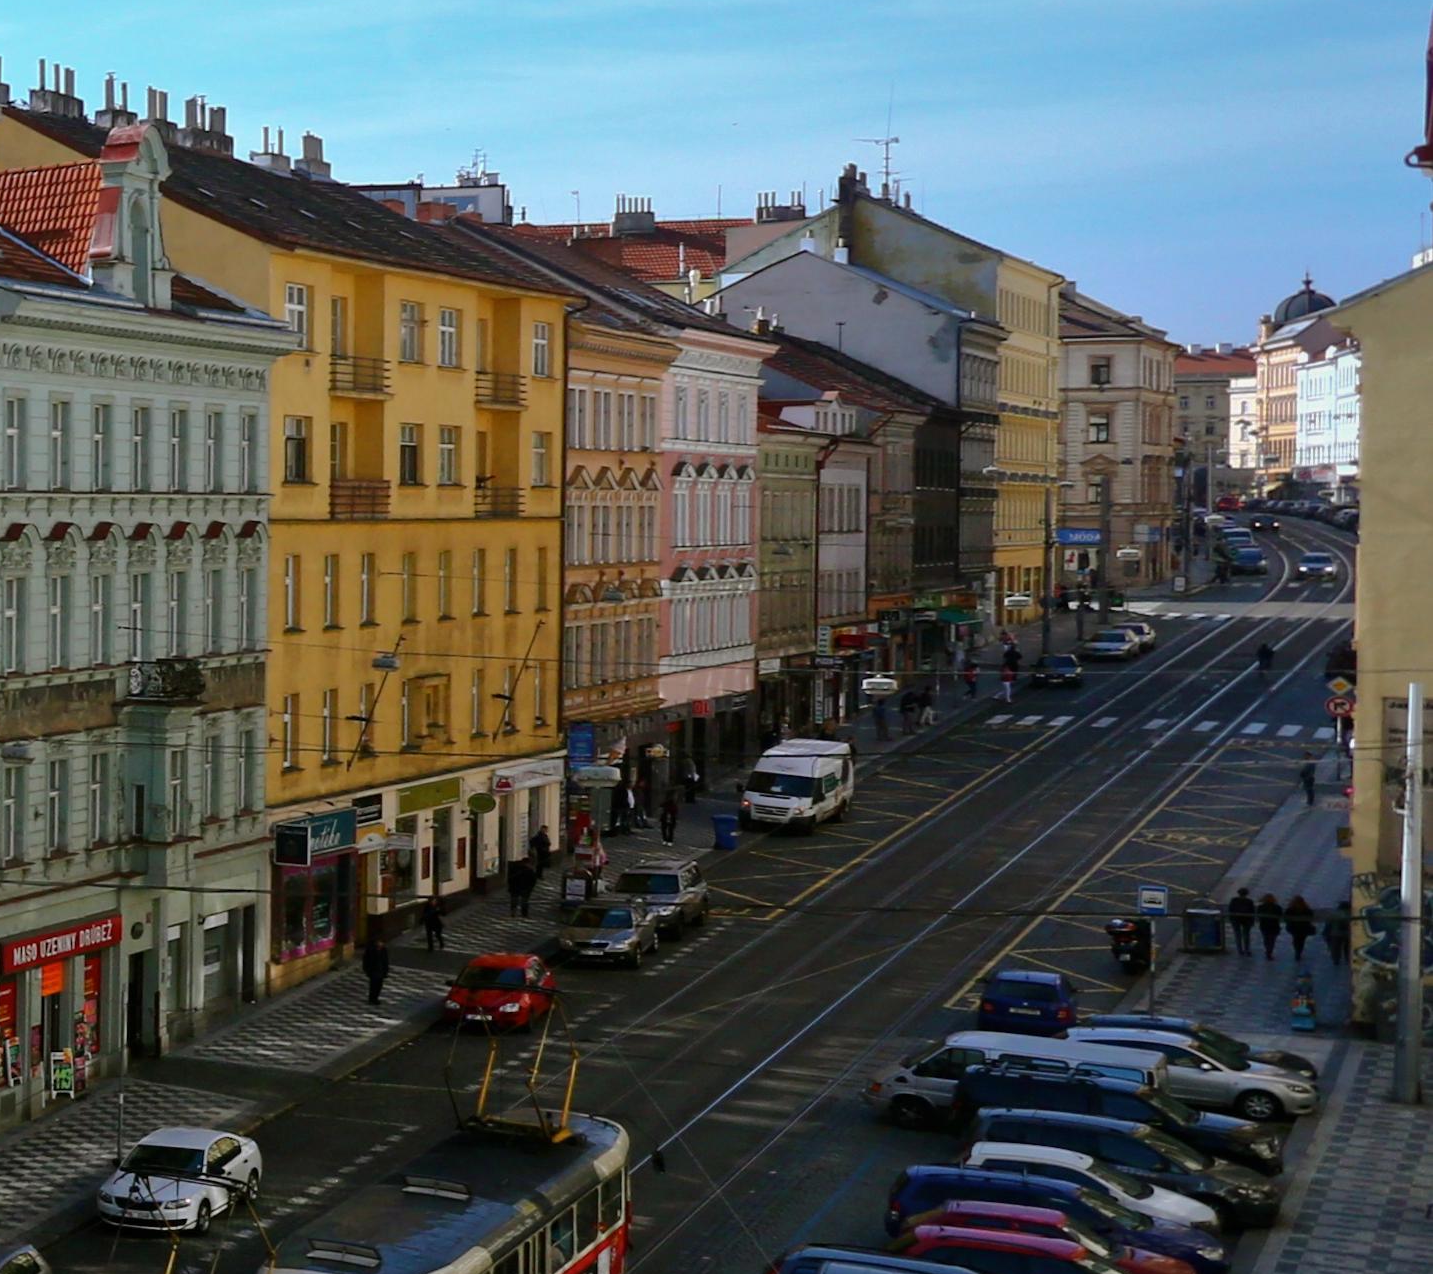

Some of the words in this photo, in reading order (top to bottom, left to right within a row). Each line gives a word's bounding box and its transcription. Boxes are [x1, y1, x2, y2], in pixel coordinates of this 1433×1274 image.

[13, 943, 38, 967] MASO
[39, 932, 77, 958] UZENINY
[79, 919, 114, 947] DRŮBEŽ
